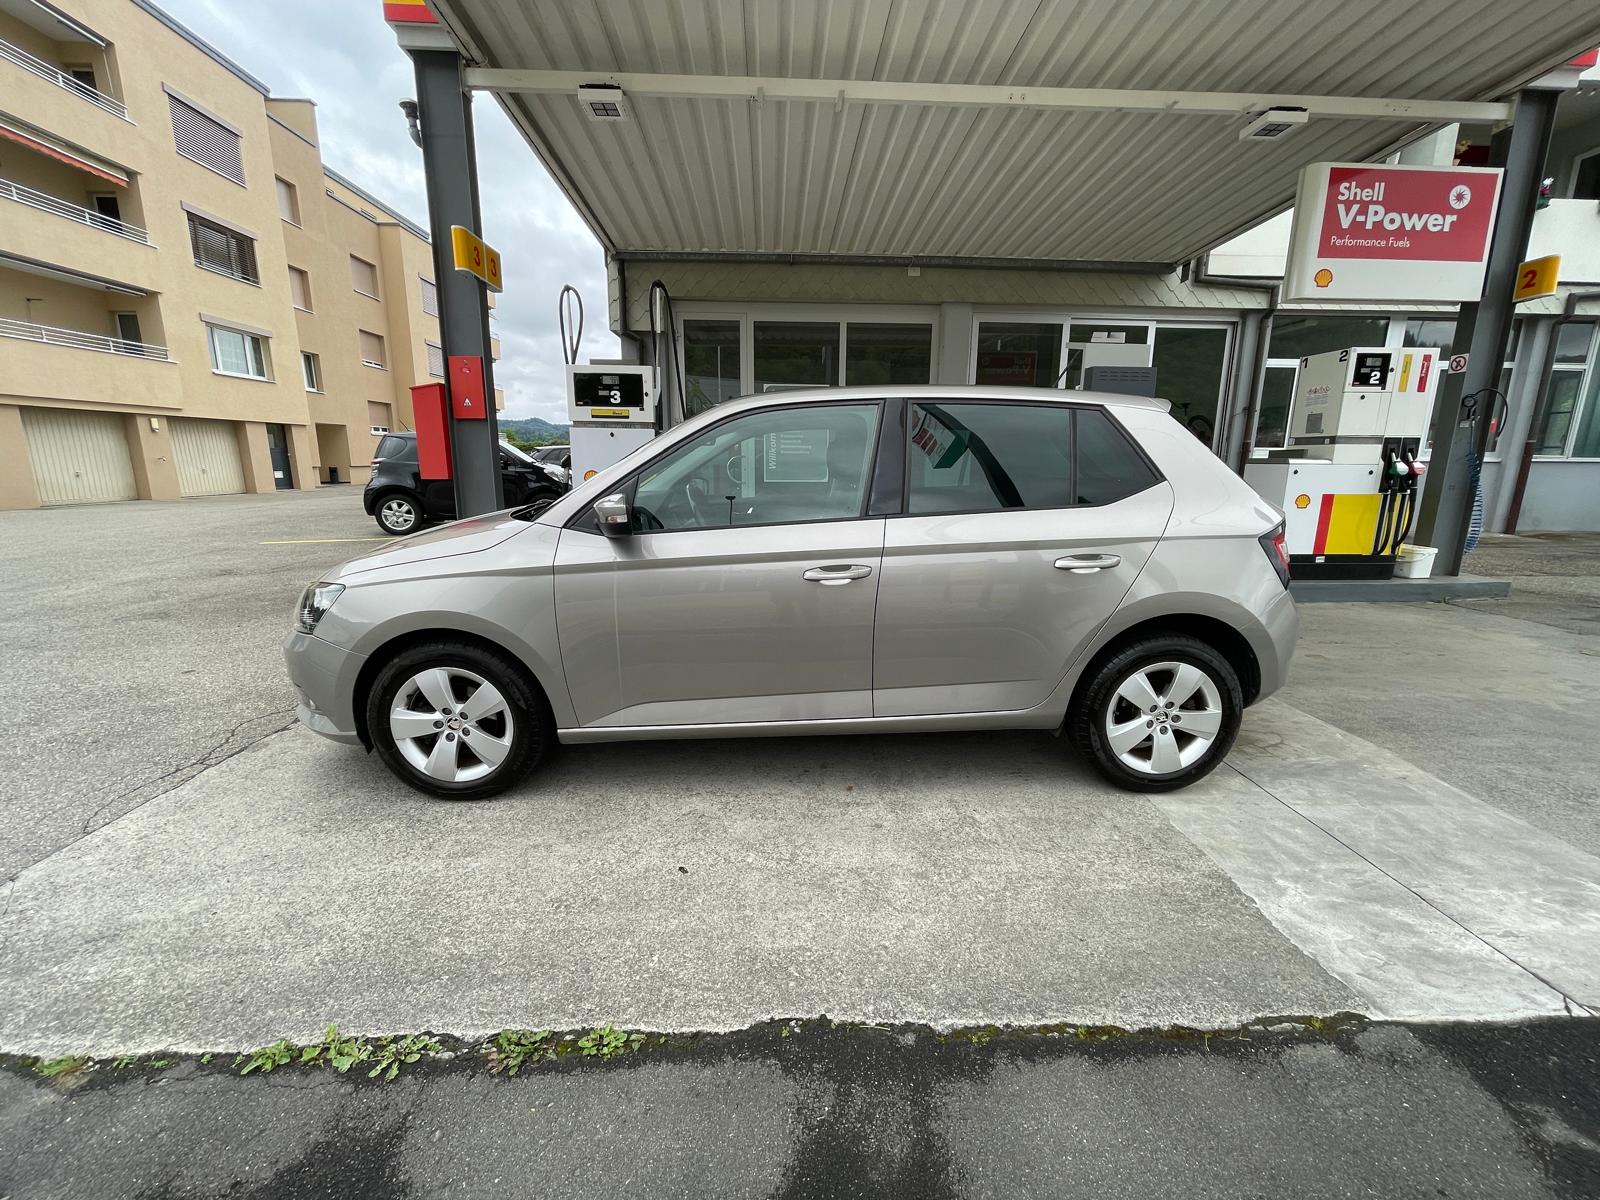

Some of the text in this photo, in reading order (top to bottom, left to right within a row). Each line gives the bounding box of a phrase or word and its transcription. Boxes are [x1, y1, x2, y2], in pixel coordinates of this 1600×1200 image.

[1338, 181, 1385, 201] Shell
[1337, 203, 1458, 232] V-Power
[1330, 235, 1411, 248] Performance Fuels
[473, 246, 481, 267] 3
[490, 257, 497, 277] 3
[1521, 269, 1537, 289] 2
[1302, 357, 1309, 368] 1
[1339, 350, 1349, 362] 2
[1369, 371, 1381, 384] 2
[610, 390, 621, 404] 3
